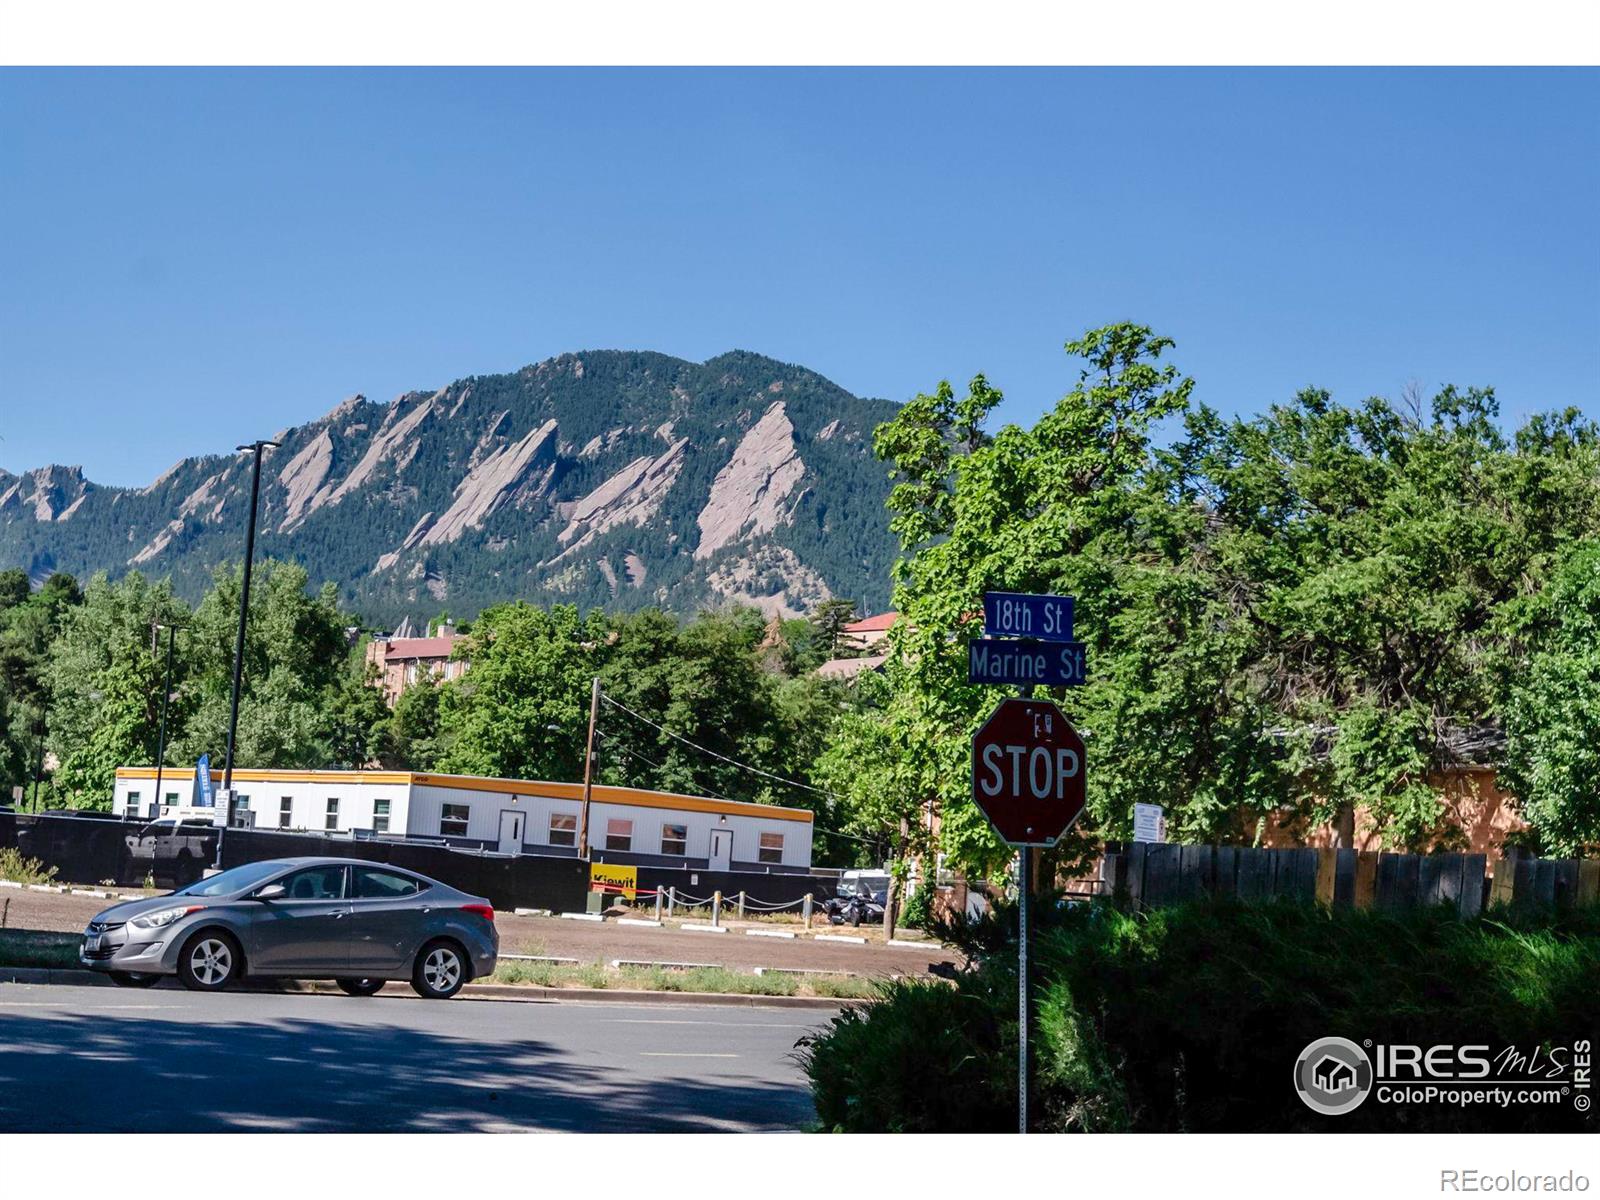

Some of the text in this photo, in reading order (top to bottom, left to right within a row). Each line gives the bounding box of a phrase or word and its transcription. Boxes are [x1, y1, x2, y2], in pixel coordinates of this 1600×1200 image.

[995, 600, 1063, 634] 18th St
[970, 646, 1082, 679] Marine St
[980, 743, 1079, 799] STOP
